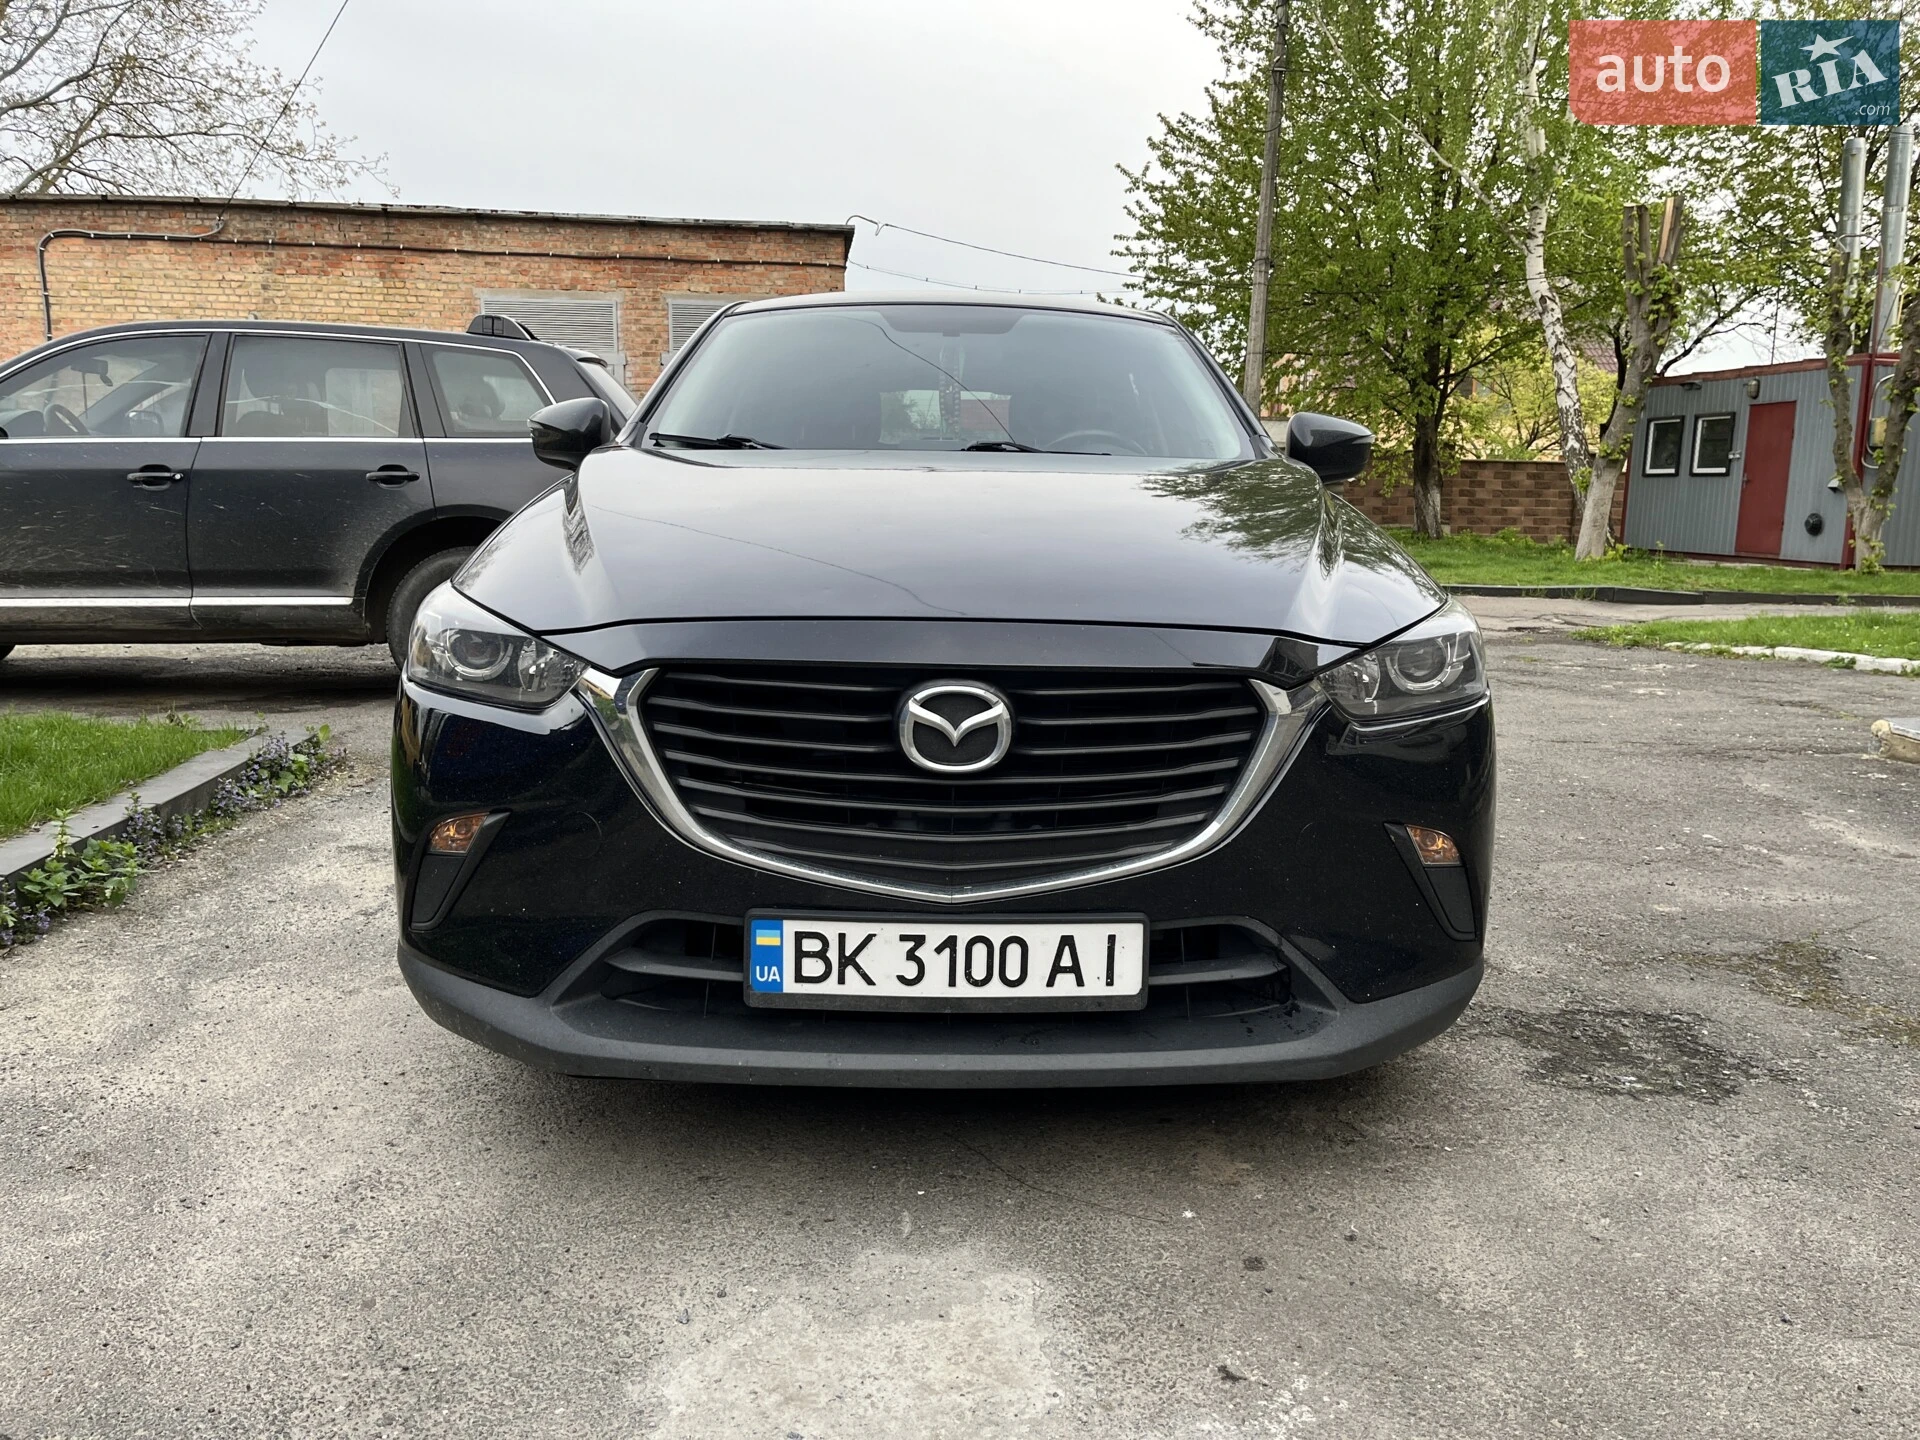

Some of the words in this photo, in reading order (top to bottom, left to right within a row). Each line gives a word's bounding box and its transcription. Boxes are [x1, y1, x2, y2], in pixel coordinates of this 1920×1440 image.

[756, 965, 781, 983] UA
[794, 931, 877, 986] BK
[896, 934, 1029, 988] 3100
